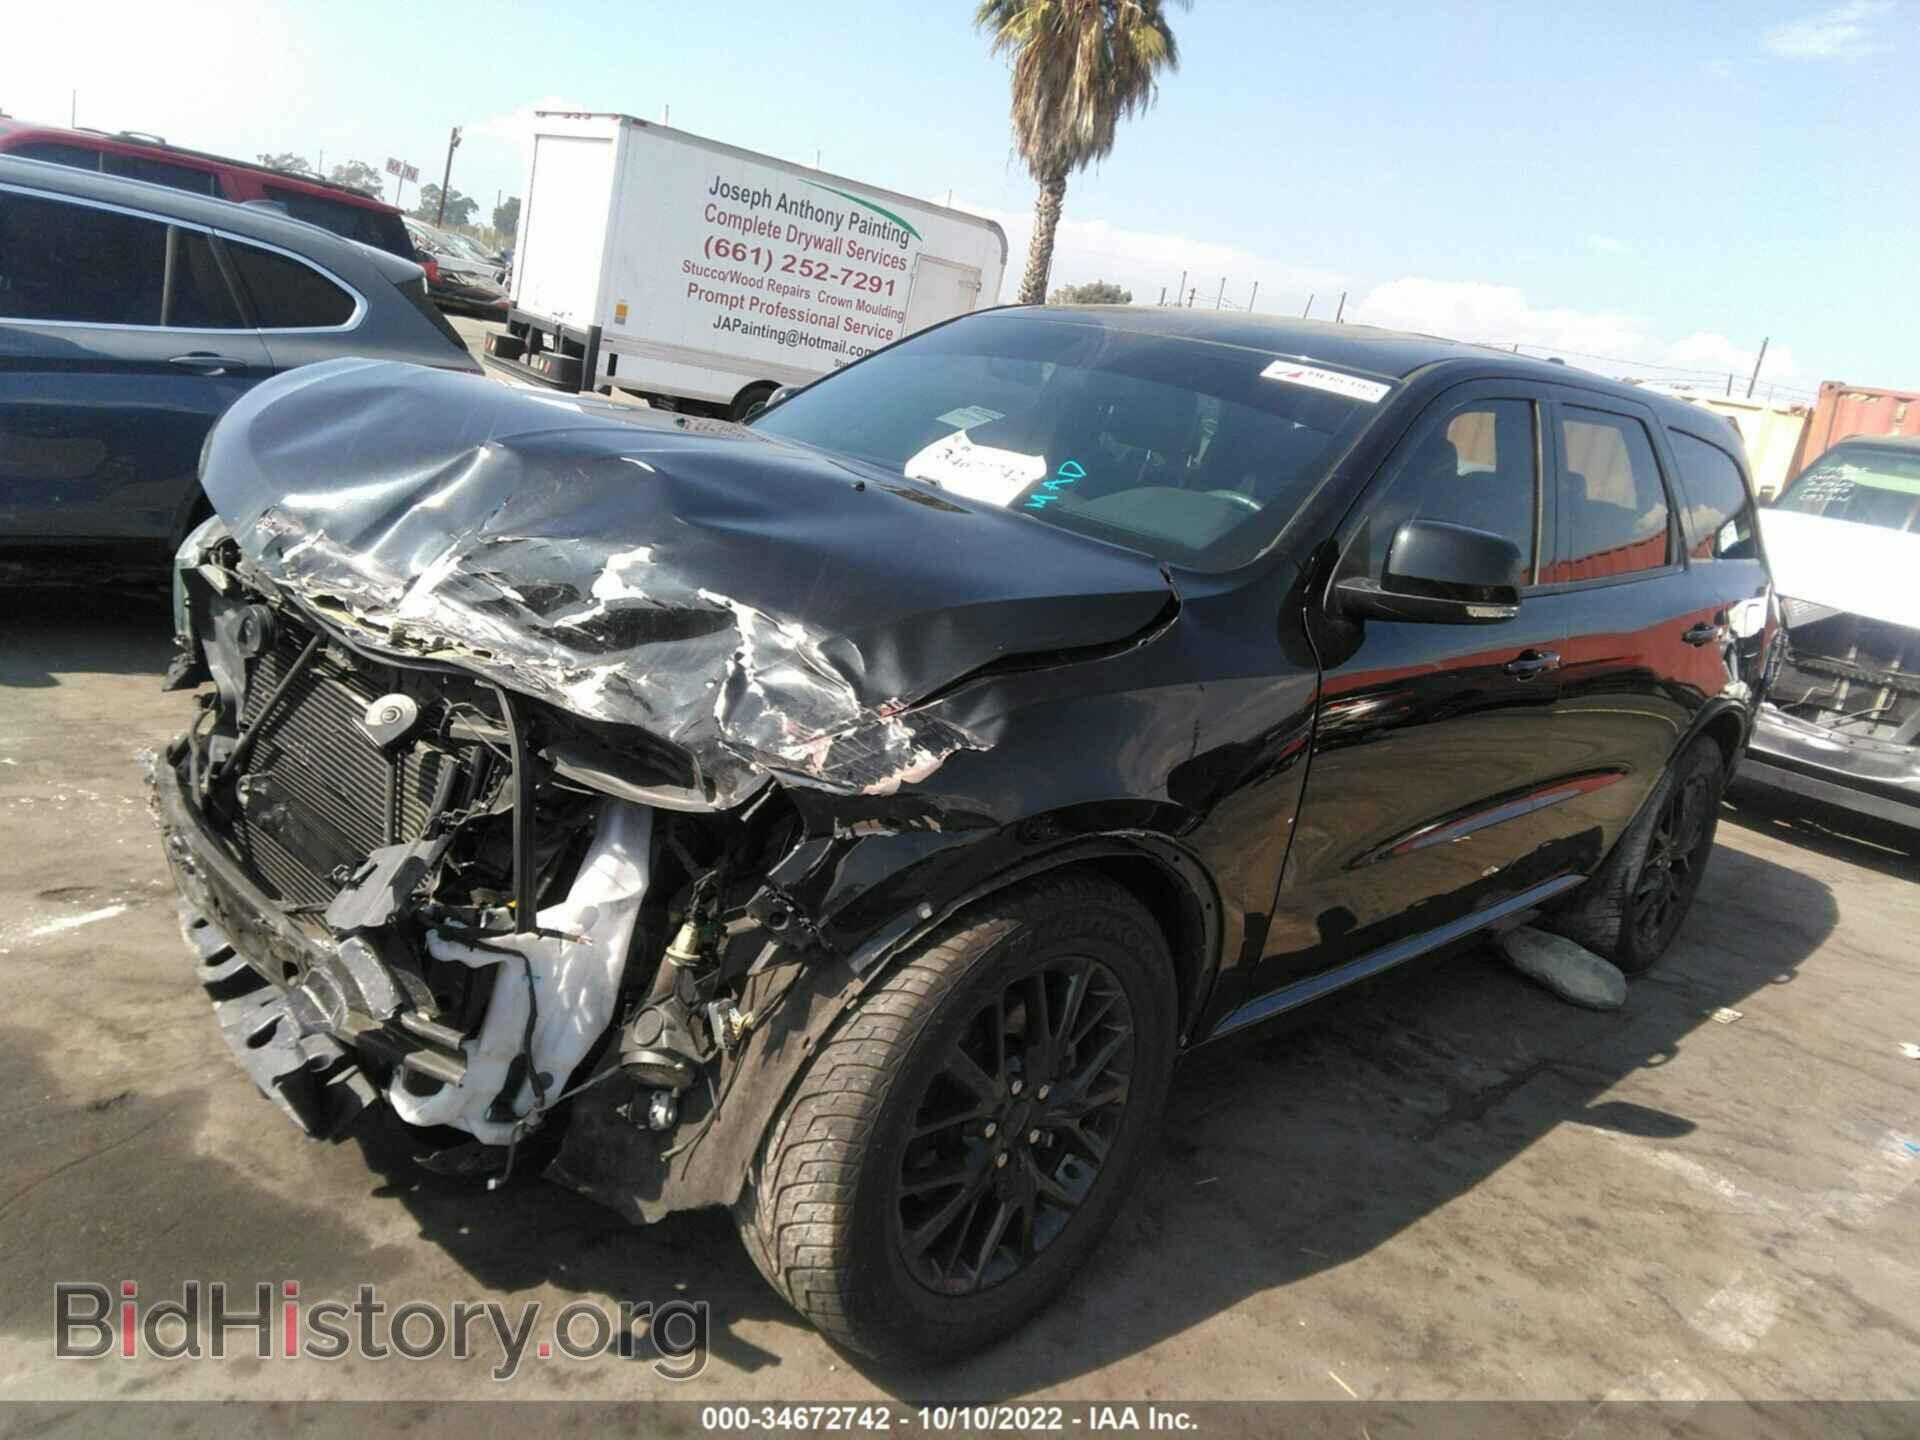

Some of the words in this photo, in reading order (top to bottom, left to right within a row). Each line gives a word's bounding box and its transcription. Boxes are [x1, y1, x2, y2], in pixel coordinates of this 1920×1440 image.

[704, 203, 781, 239] Complete
[786, 224, 844, 255] Drywall
[846, 240, 908, 271] Services
[709, 176, 772, 210] Joseph
[775, 193, 845, 232] Anthony
[848, 211, 910, 250] Painting
[681, 259, 764, 289] Stucco/Wood
[767, 278, 811, 300] Repairs
[817, 290, 853, 309] Crown
[855, 299, 905, 324] Moulding
[704, 235, 773, 273] (661)
[780, 254, 896, 297] 252-7291
[687, 282, 745, 311] Prompt
[749, 296, 841, 329] Professional
[843, 317, 894, 341] Service
[1024, 460, 1087, 509] MAD
